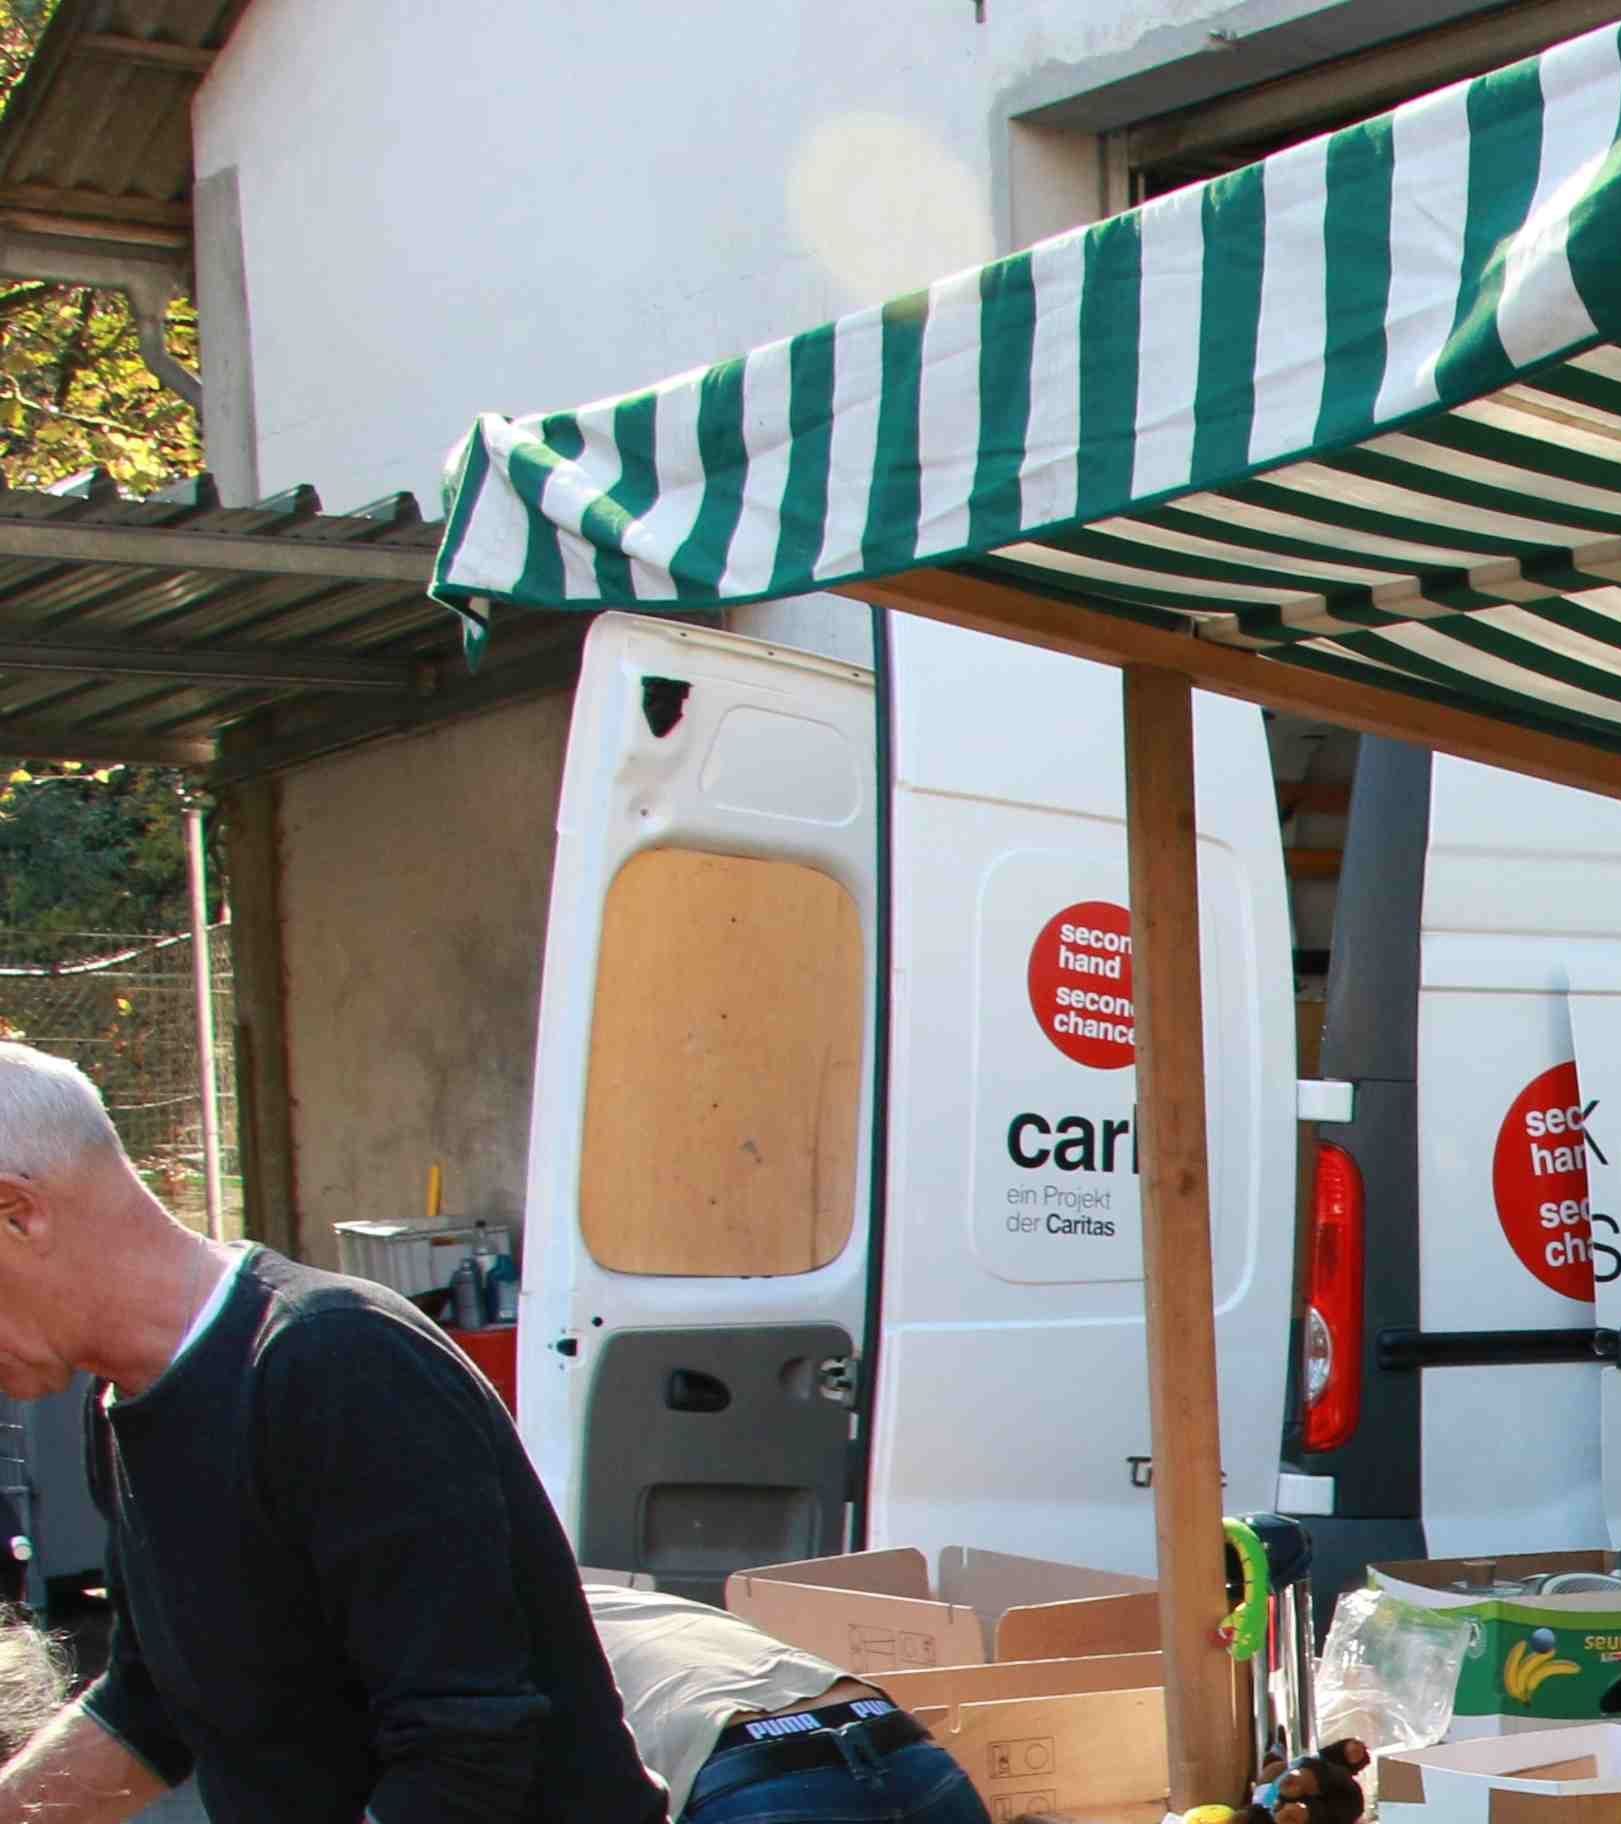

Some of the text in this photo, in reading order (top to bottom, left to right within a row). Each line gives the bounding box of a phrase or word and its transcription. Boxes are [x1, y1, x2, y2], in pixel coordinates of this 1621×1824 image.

[1060, 923, 1133, 955] secon
[1059, 945, 1121, 979] hand
[1056, 986, 1135, 1017] secon
[1007, 1183, 1111, 1212] ein Projekt
[1006, 1212, 1116, 1237] der Caritas
[746, 1713, 821, 1740] PUMA
